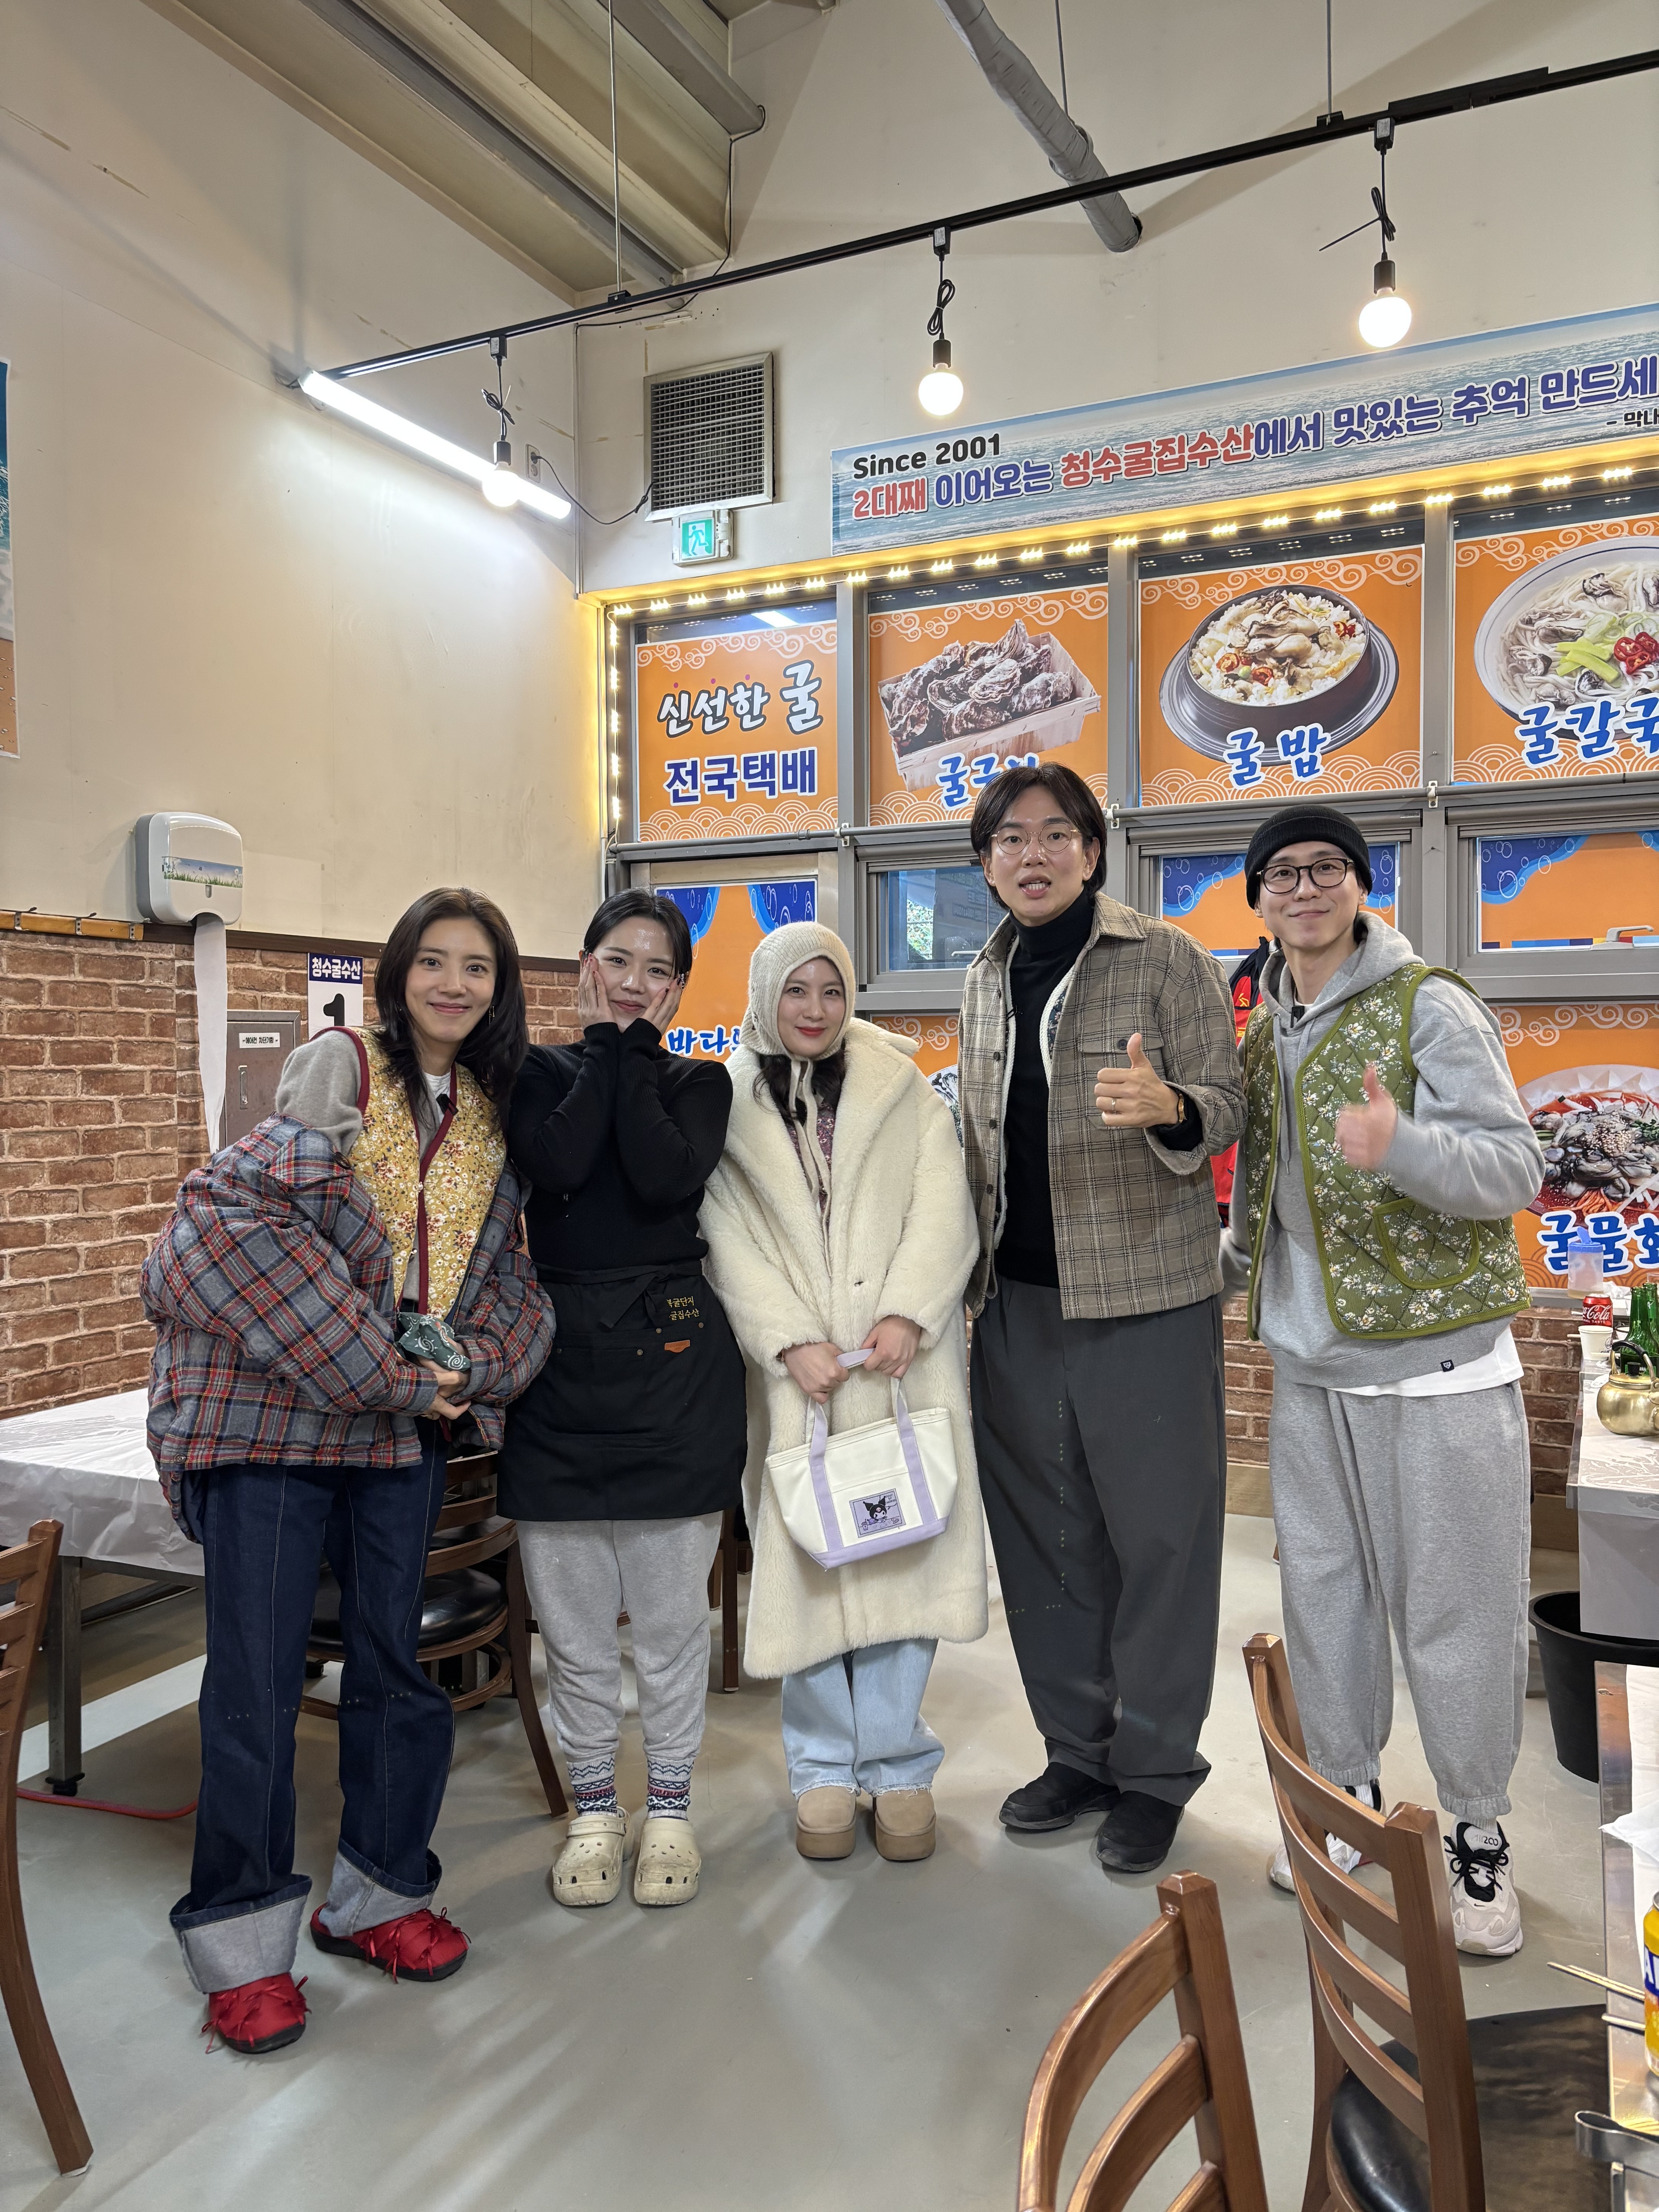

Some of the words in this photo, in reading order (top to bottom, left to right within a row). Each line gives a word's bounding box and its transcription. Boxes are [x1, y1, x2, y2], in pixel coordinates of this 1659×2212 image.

[853, 478, 926, 519] 2대째
[935, 460, 1052, 506] 이어오는
[1061, 411, 1321, 487] 청수굴집수산에서
[1334, 398, 1441, 443] 맛있는
[1451, 377, 1527, 424] 추억
[853, 451, 927, 479] Since
[935, 433, 1000, 465] 2001
[659, 683, 769, 737] 신선한
[781, 662, 821, 733] 굴
[665, 749, 815, 804] 전국택배
[312, 957, 361, 980] 청수굴수산
[323, 993, 345, 1026] 1
[669, 1308, 699, 1321] 굴집수산
